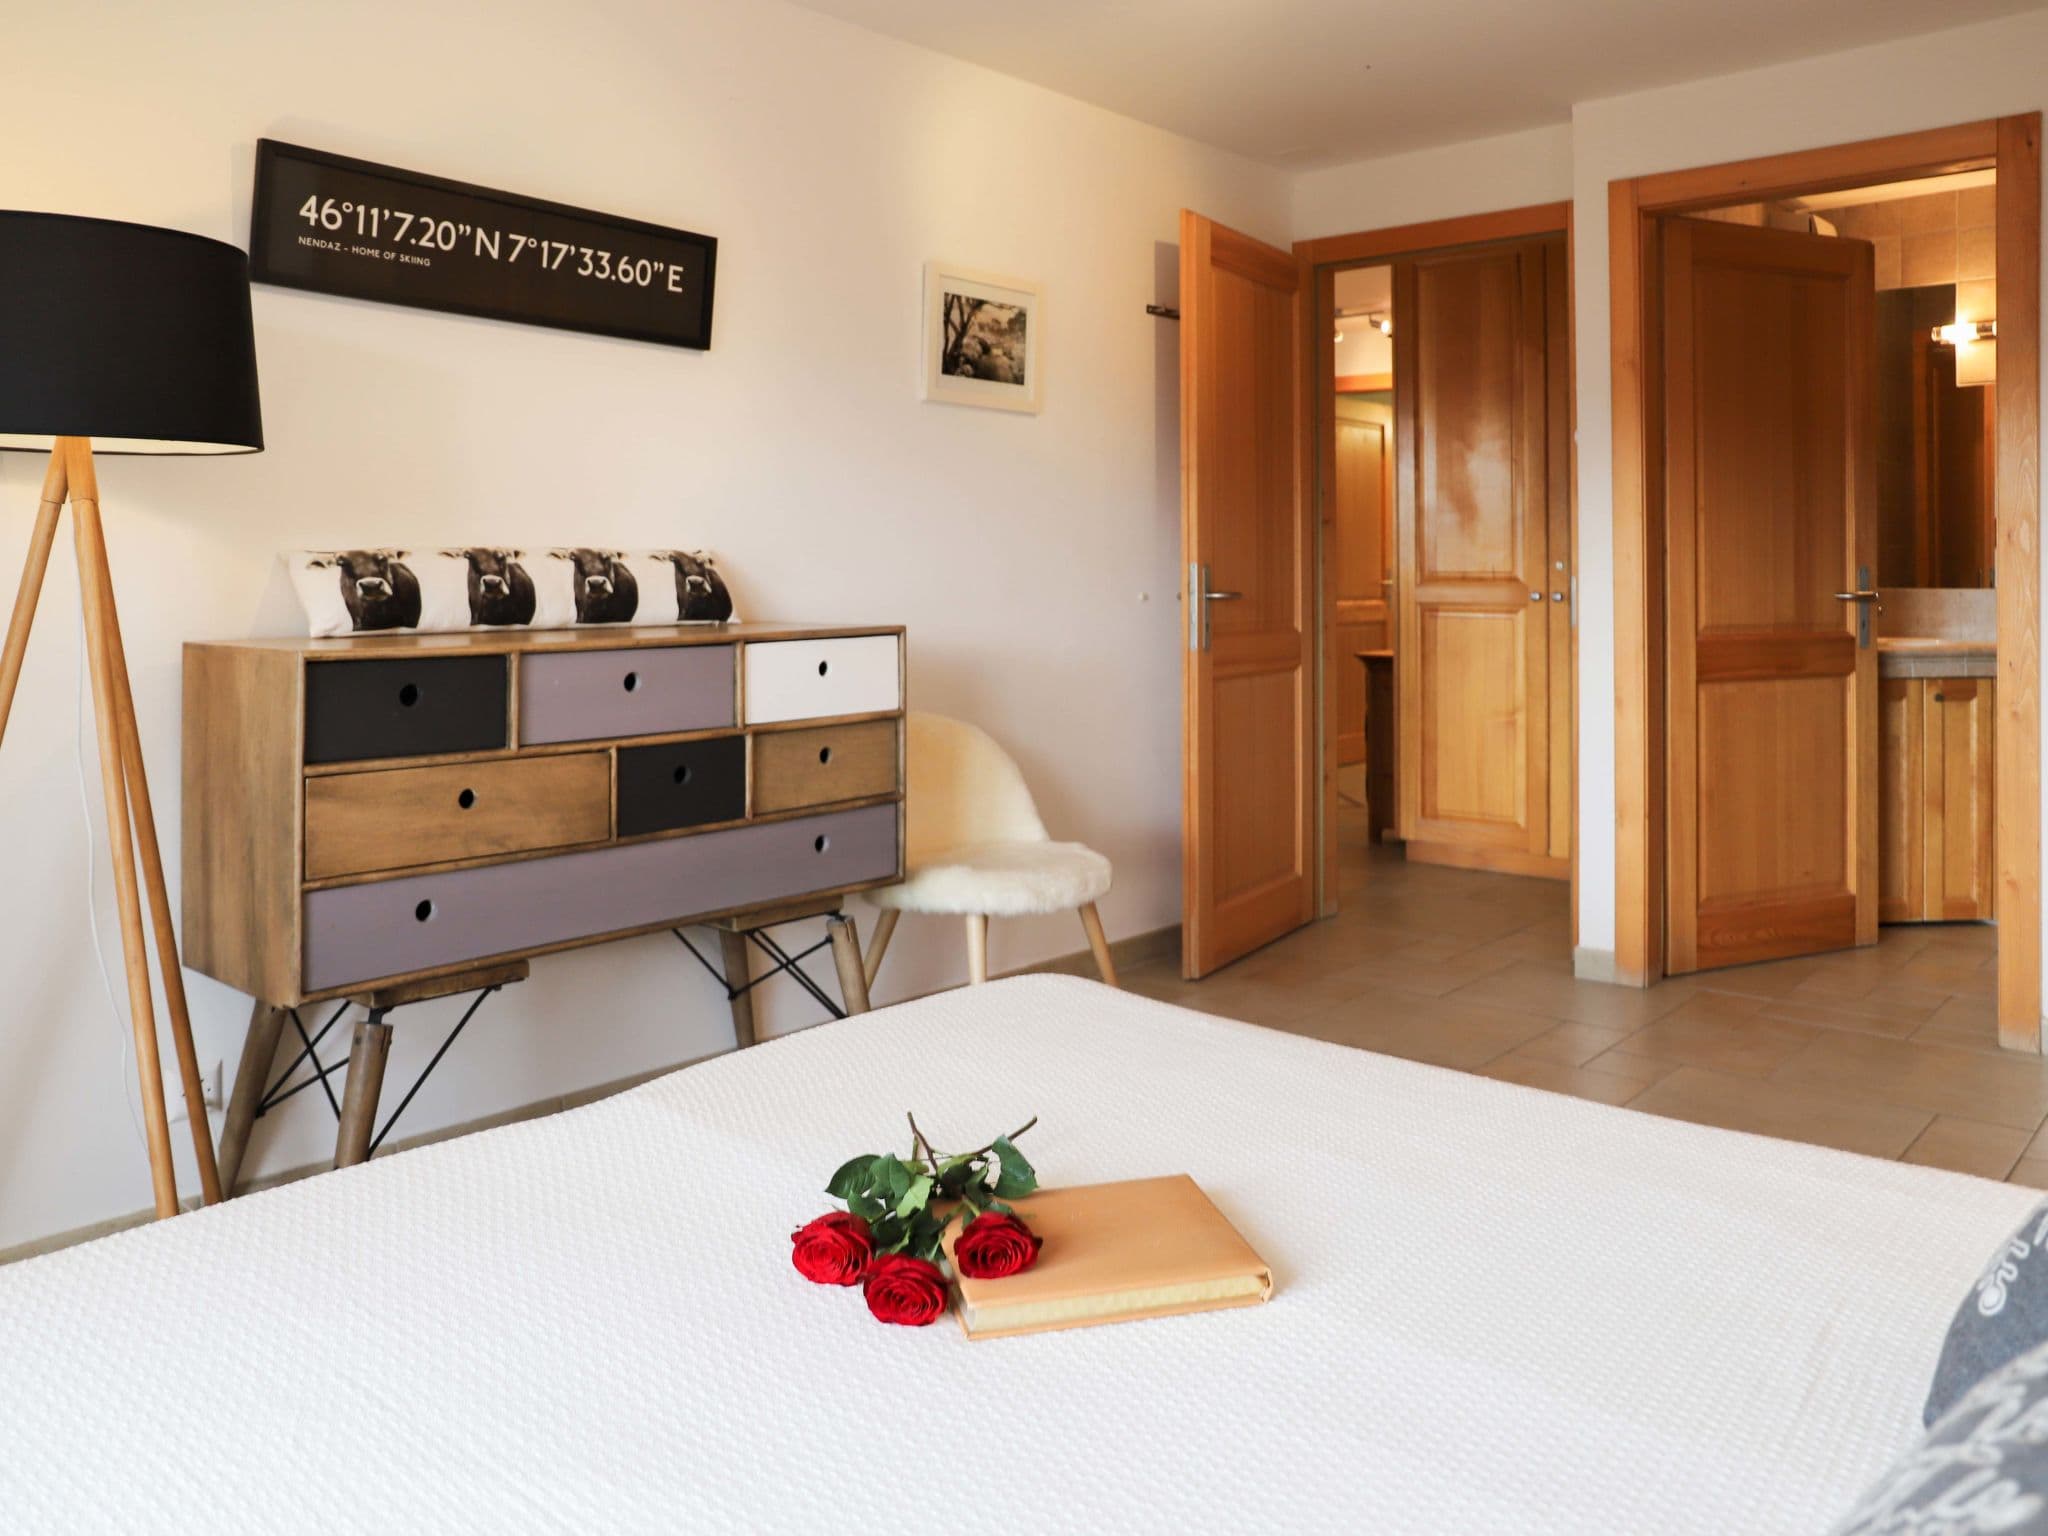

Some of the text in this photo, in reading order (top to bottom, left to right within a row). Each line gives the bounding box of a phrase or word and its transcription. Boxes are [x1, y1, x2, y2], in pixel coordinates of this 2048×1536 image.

[298, 235, 342, 252] NENDAZ
[351, 246, 380, 258] HOME
[383, 251, 396, 260] OF
[399, 253, 431, 267] SKIING
